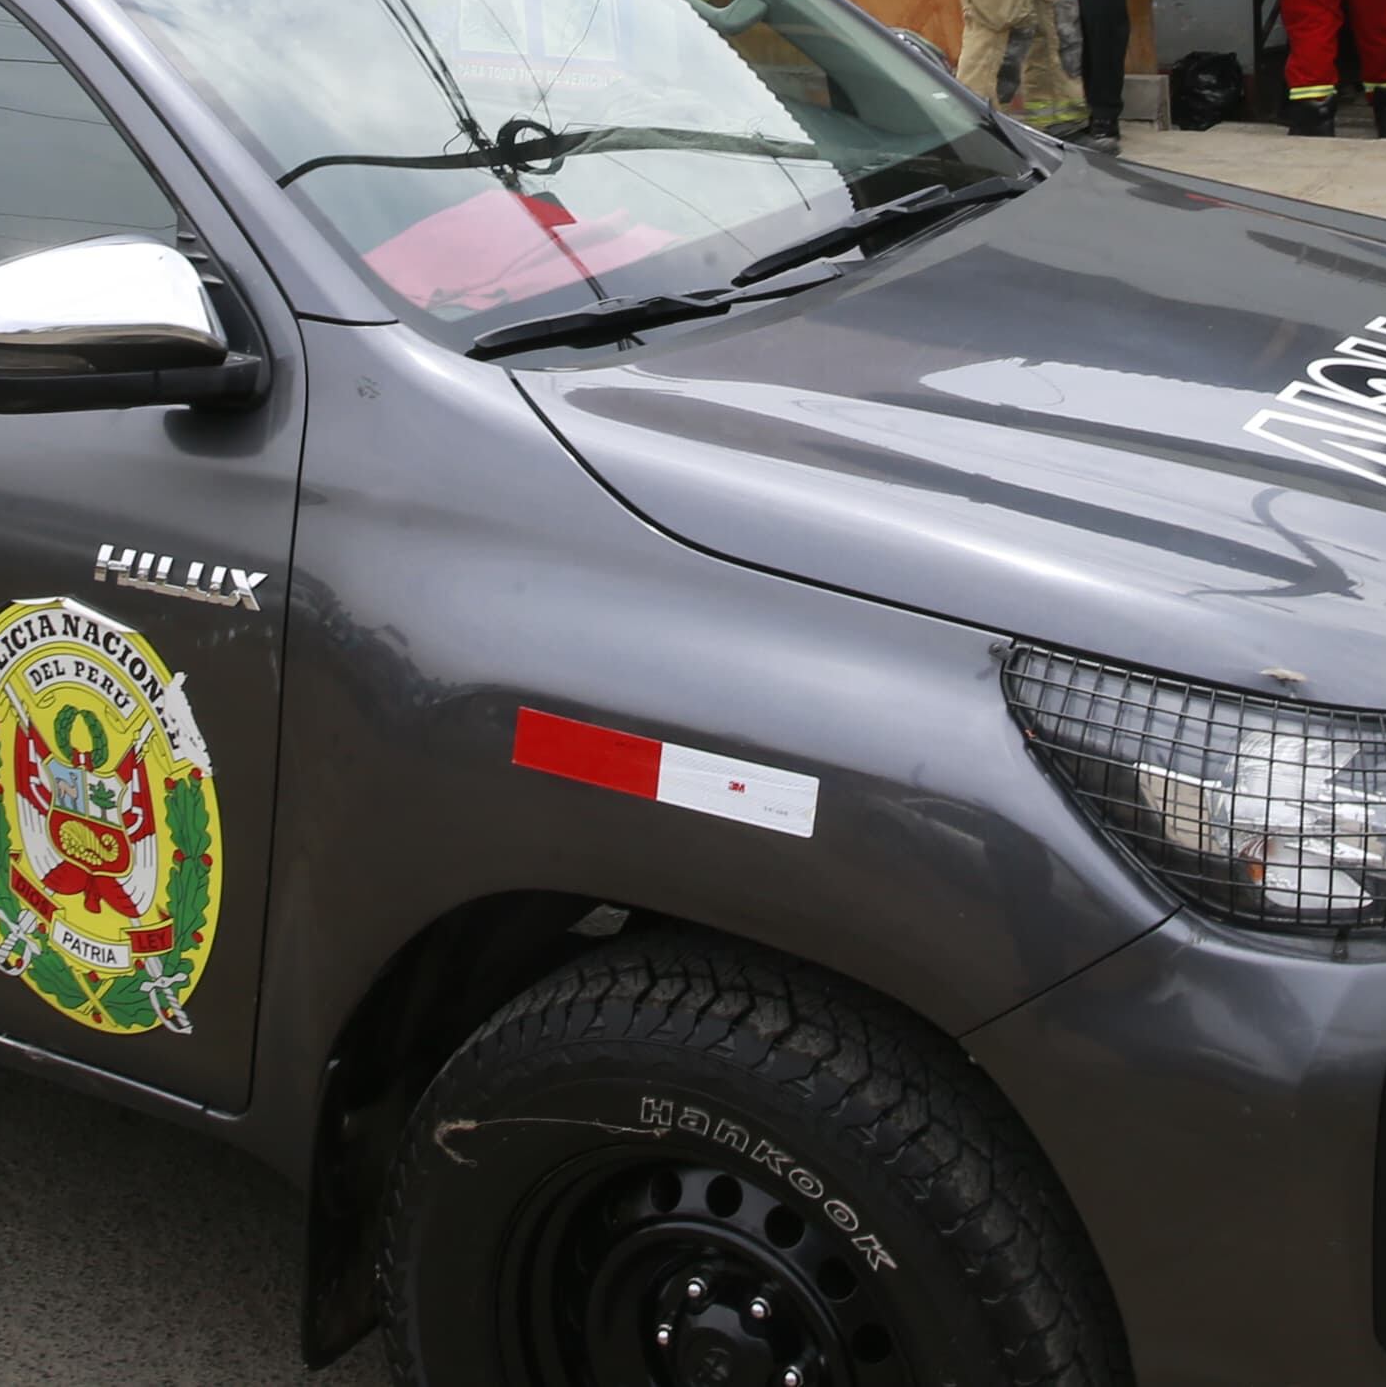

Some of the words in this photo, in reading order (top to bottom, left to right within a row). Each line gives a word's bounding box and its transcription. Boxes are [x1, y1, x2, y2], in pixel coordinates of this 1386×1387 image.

[94, 543, 269, 611] HILUX
[29, 659, 66, 688] DEL
[75, 660, 131, 709] PERÚ
[61, 613, 181, 750] NACIONL
[62, 931, 118, 964] PATRIA
[138, 929, 166, 950] LEY
